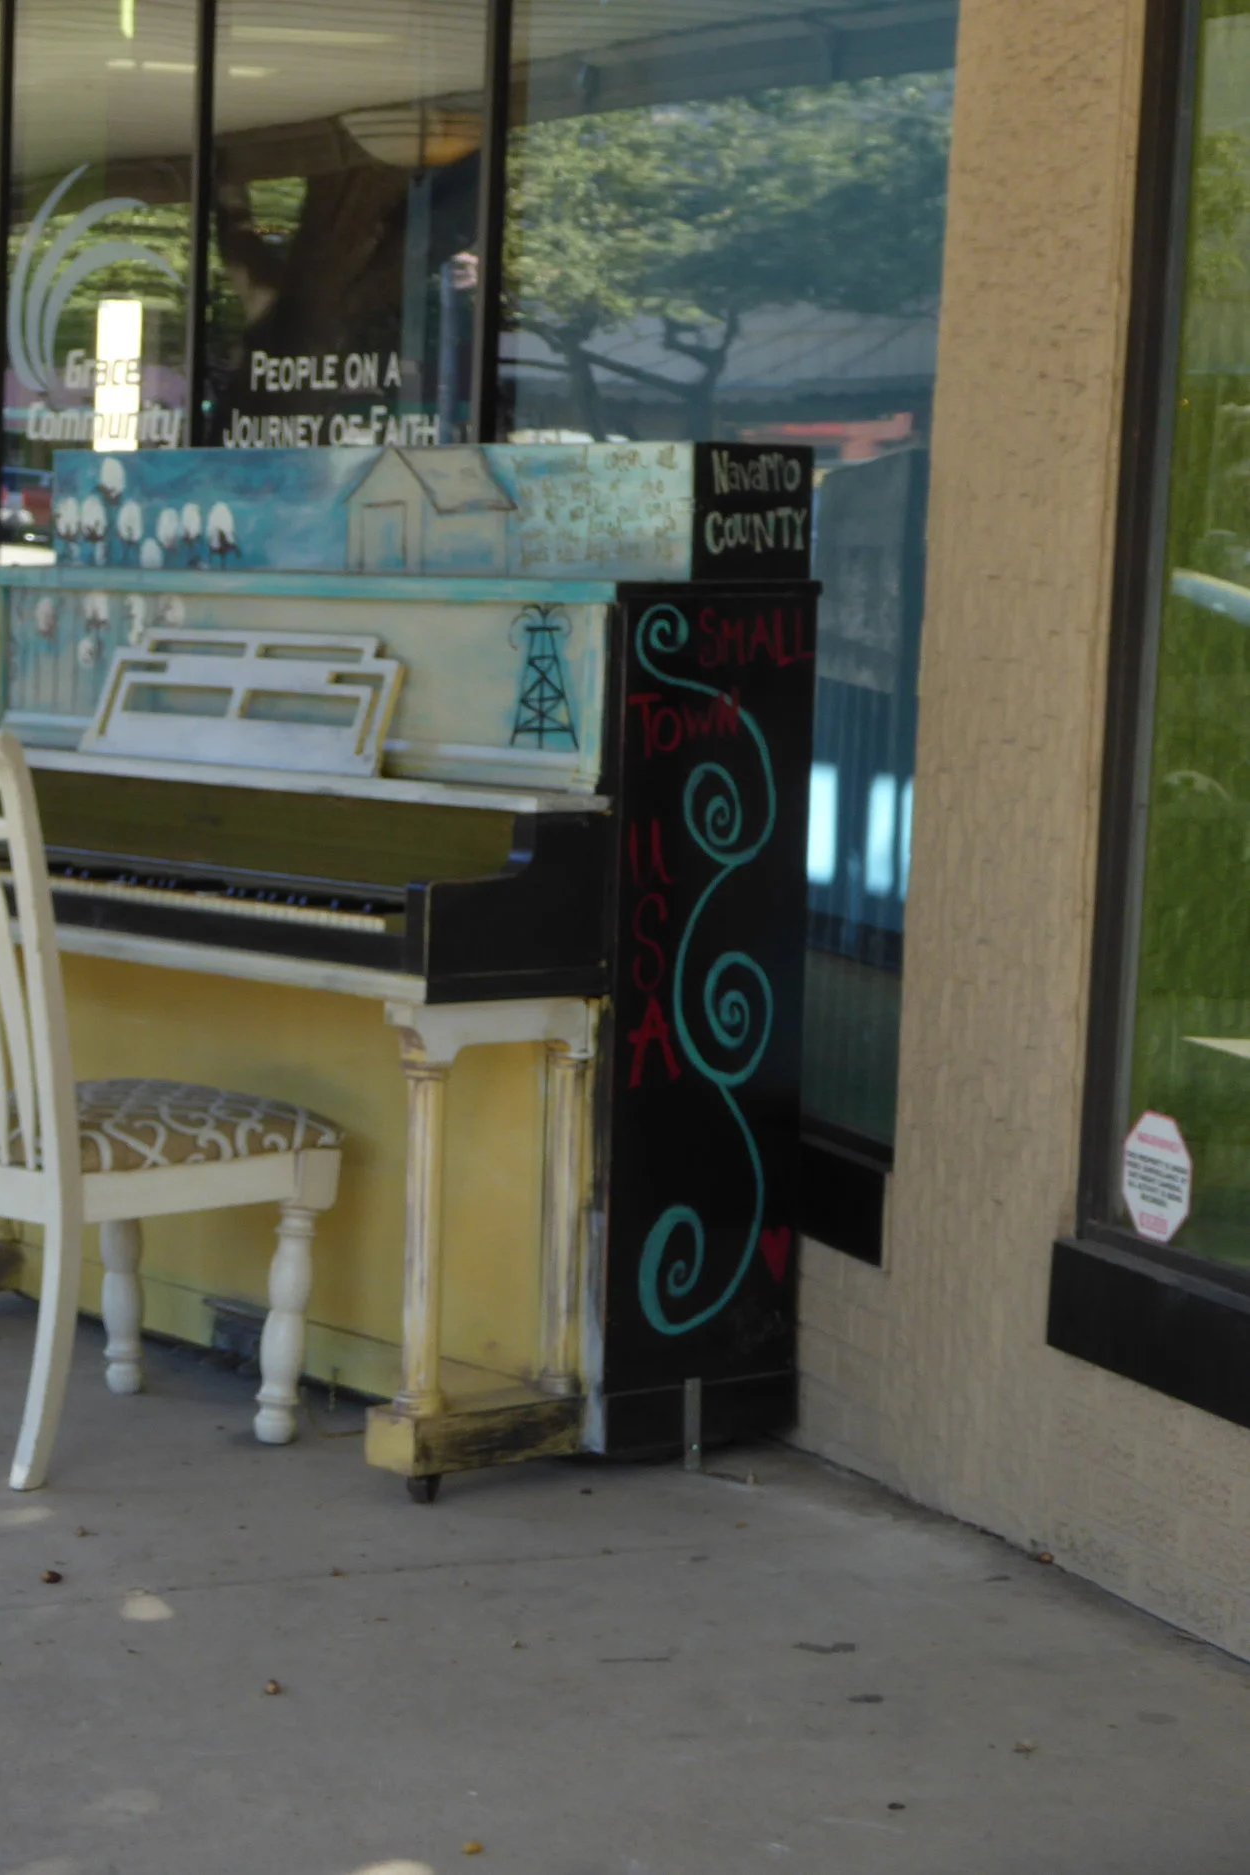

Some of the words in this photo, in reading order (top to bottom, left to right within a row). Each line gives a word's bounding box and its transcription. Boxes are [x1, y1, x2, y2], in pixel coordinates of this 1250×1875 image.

[65, 348, 141, 389] Grace
[251, 351, 338, 391] PEOPLE
[344, 352, 379, 389] ON
[383, 351, 401, 388] A
[25, 401, 186, 449] Community
[223, 408, 324, 448] JOURNEY
[369, 405, 440, 446] FAITH
[699, 607, 815, 668] SMALL
[628, 686, 740, 759] TOWN
